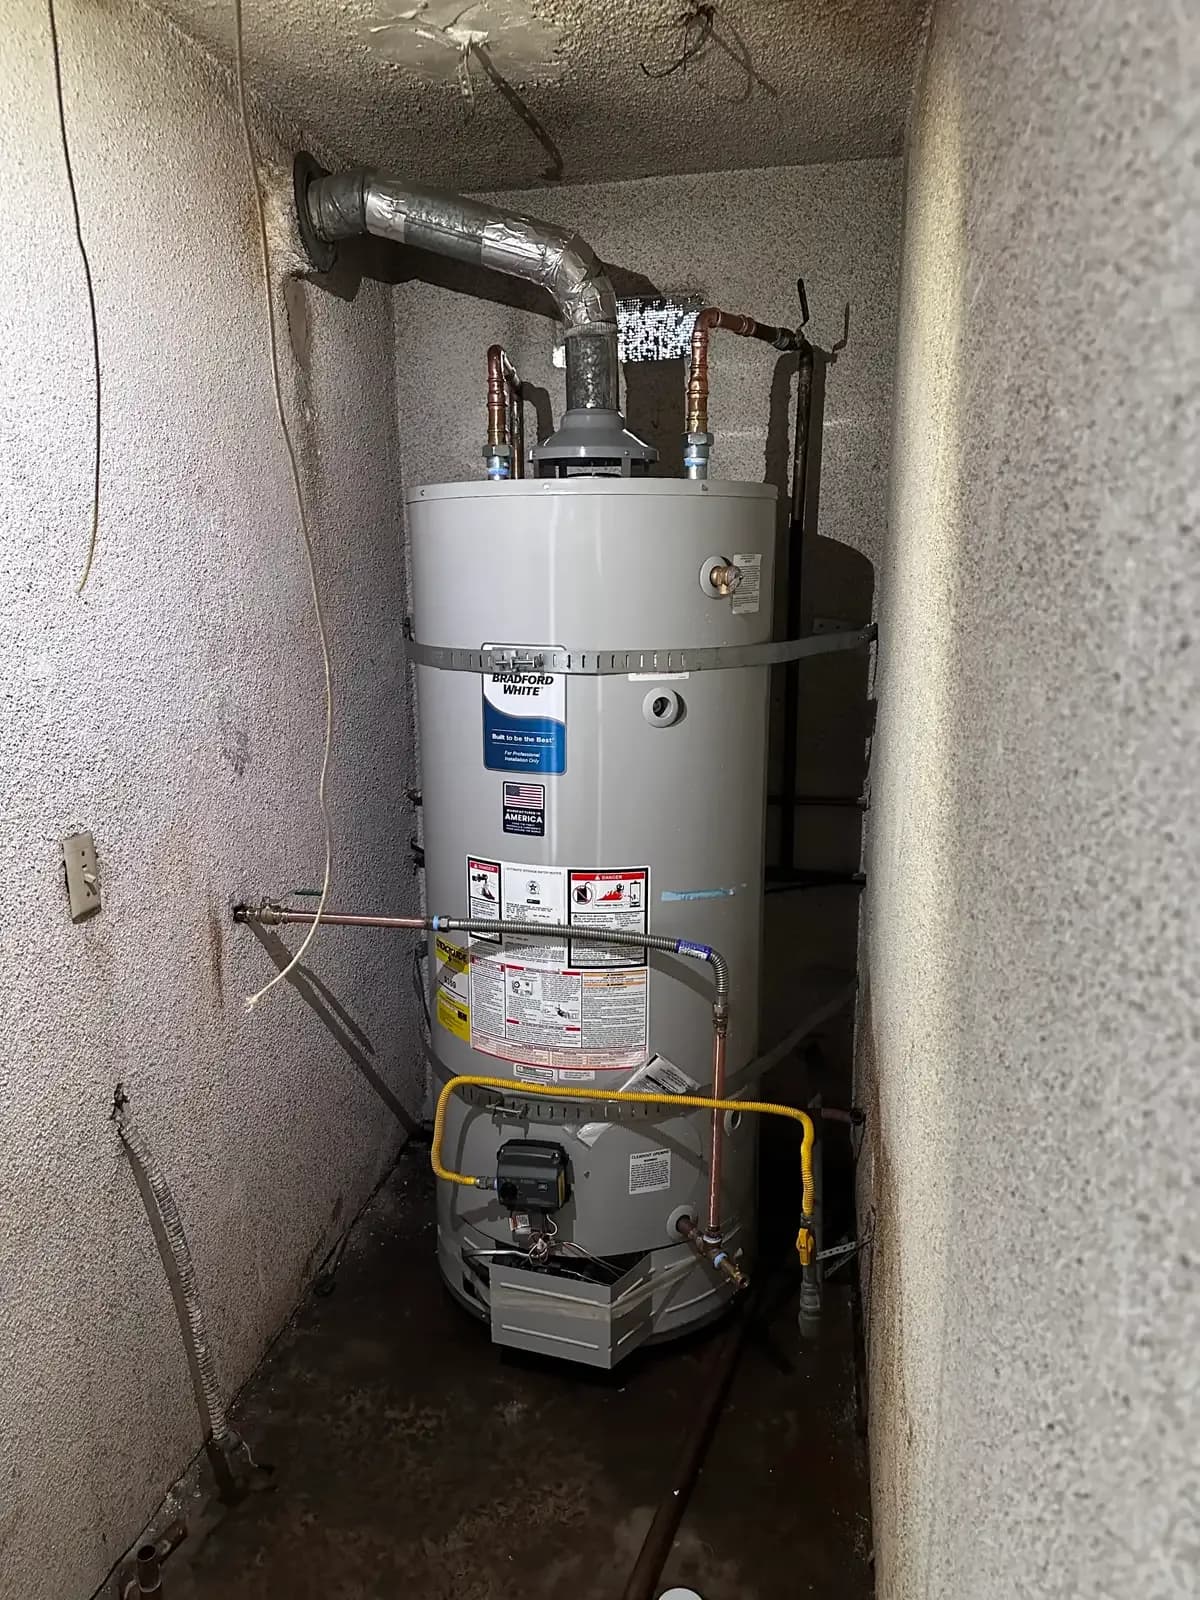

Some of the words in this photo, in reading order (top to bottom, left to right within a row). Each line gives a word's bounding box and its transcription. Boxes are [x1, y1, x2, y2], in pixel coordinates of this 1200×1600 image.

[492, 673, 554, 685] BRADFORD
[512, 750, 541, 758] Professional
[504, 812, 543, 824] AMERICA
